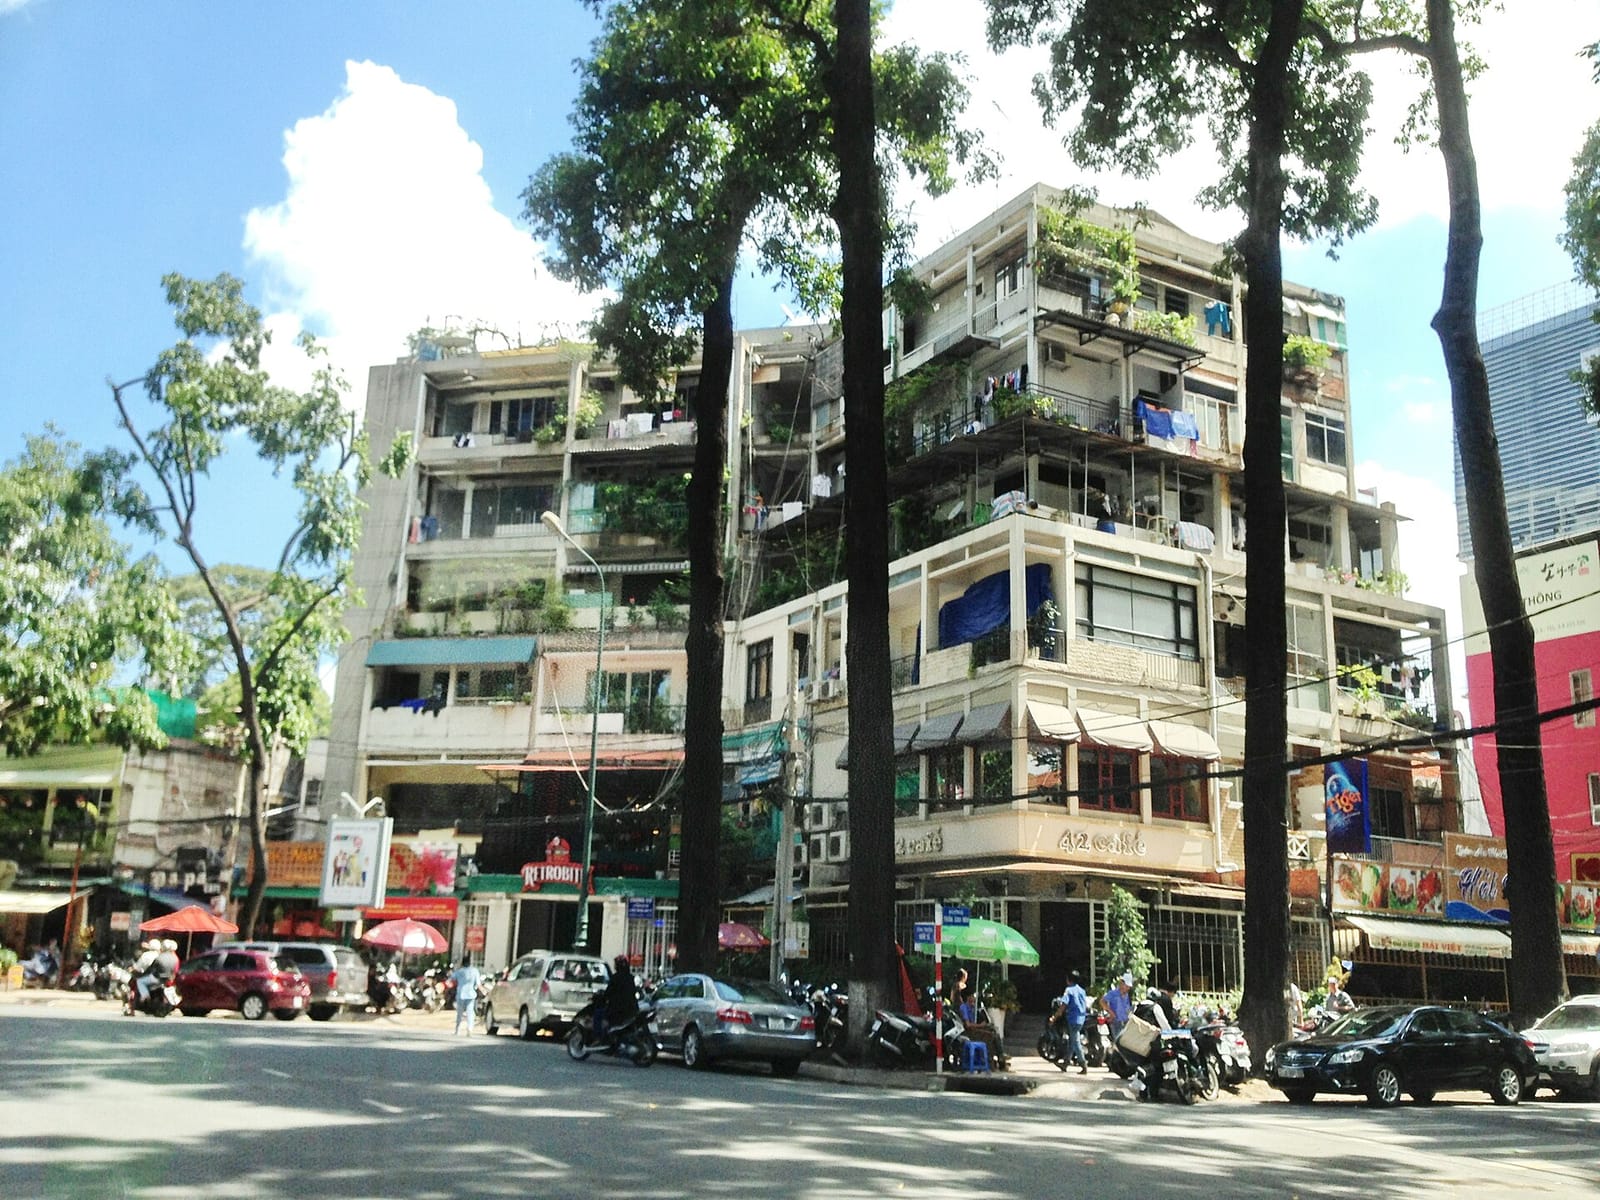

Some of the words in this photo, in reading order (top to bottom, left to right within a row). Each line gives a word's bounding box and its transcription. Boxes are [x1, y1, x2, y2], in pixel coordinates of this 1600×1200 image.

[1327, 789, 1362, 814] Tiger
[1058, 828, 1091, 855] 42
[1092, 829, 1146, 857] café
[525, 865, 583, 888] RETROBIT
